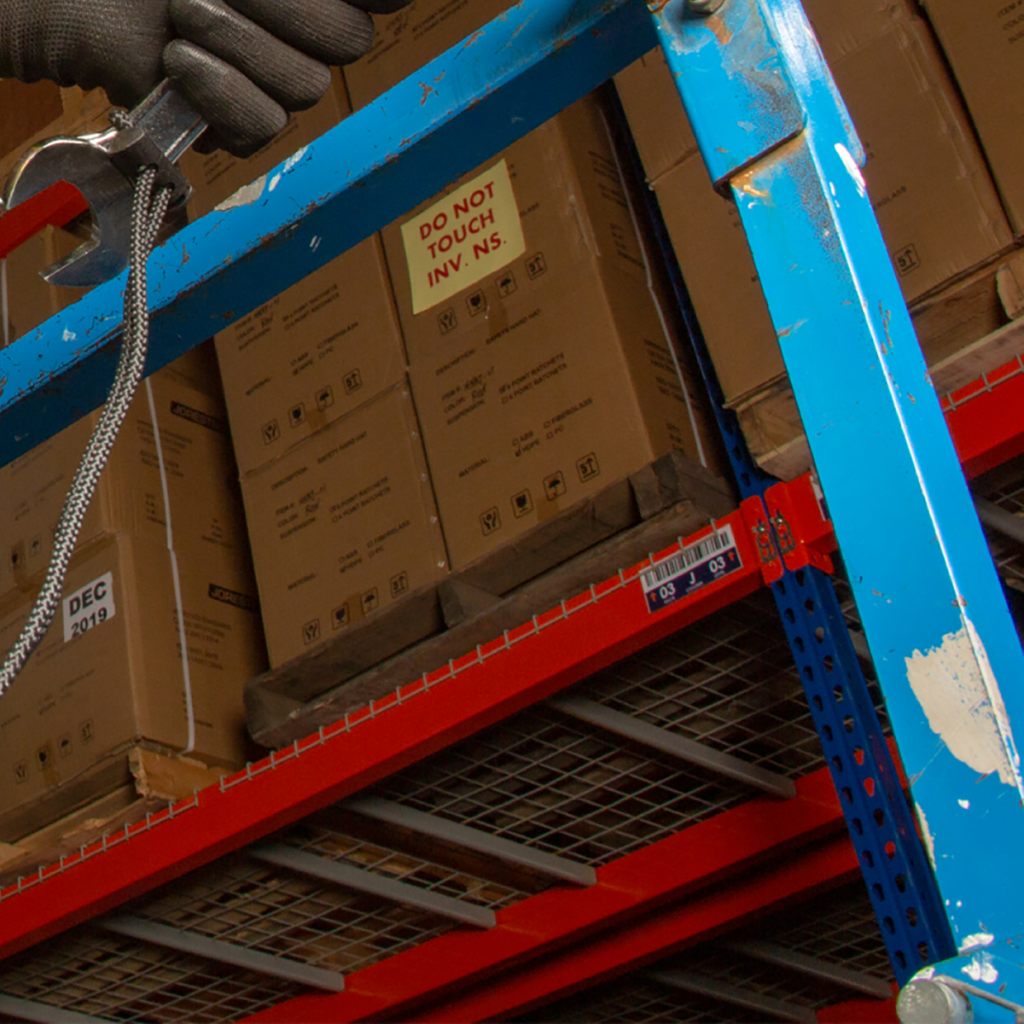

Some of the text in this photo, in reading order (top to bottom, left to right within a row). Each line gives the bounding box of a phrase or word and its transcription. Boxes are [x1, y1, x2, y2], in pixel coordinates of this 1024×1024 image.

[419, 180, 495, 241] DO NOT
[427, 208, 495, 259] TOUCH
[511, 372, 530, 387] POINT
[531, 352, 564, 376] RATCHETS
[514, 362, 566, 397] POINT RATCHETS
[659, 556, 726, 600] 03 J 03
[69, 581, 107, 617] DEC
[71, 606, 108, 637] 2019
